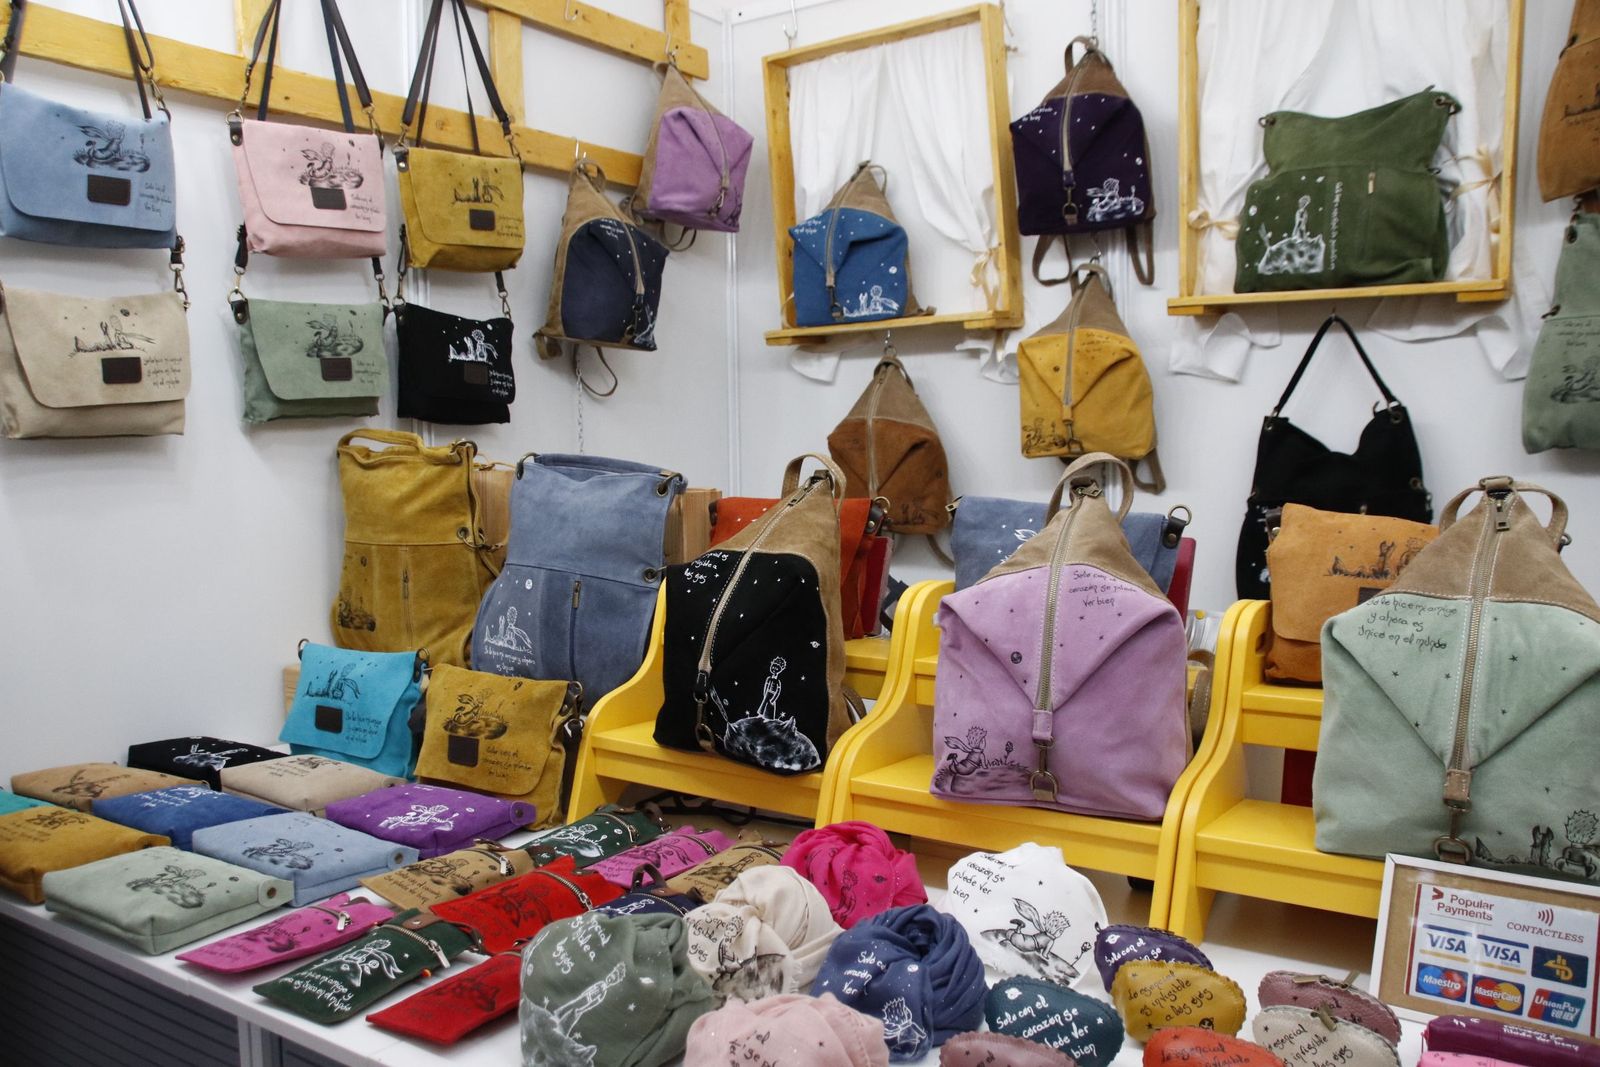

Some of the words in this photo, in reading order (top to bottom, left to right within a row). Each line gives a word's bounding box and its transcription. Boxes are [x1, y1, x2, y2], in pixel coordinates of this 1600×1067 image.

[1403, 633, 1415, 644] el
[952, 885, 970, 904] bien
[1450, 894, 1495, 911] Popular
[1437, 902, 1493, 921] Payments
[1506, 921, 1584, 944] CONTACTLESS
[1427, 933, 1467, 954] VISA
[1482, 943, 1521, 964] VISA
[1105, 952, 1121, 966] Solo
[1122, 944, 1138, 956] con
[1152, 978, 1192, 1008] invisible
[1422, 974, 1462, 991] Maestro
[1171, 1003, 1192, 1016] los
[1191, 988, 1214, 1008] ojos
[1473, 985, 1522, 1004] MasterCard
[1534, 995, 1581, 1015] UnionPay
[996, 1011, 1017, 1029] Solo
[1018, 1006, 1036, 1017] con
[1035, 994, 1049, 1009] el
[1022, 1013, 1064, 1039] corazón
[1273, 1023, 1308, 1050] esencial
[1071, 1043, 1097, 1059] bien
[1293, 1033, 1328, 1063] invisible
